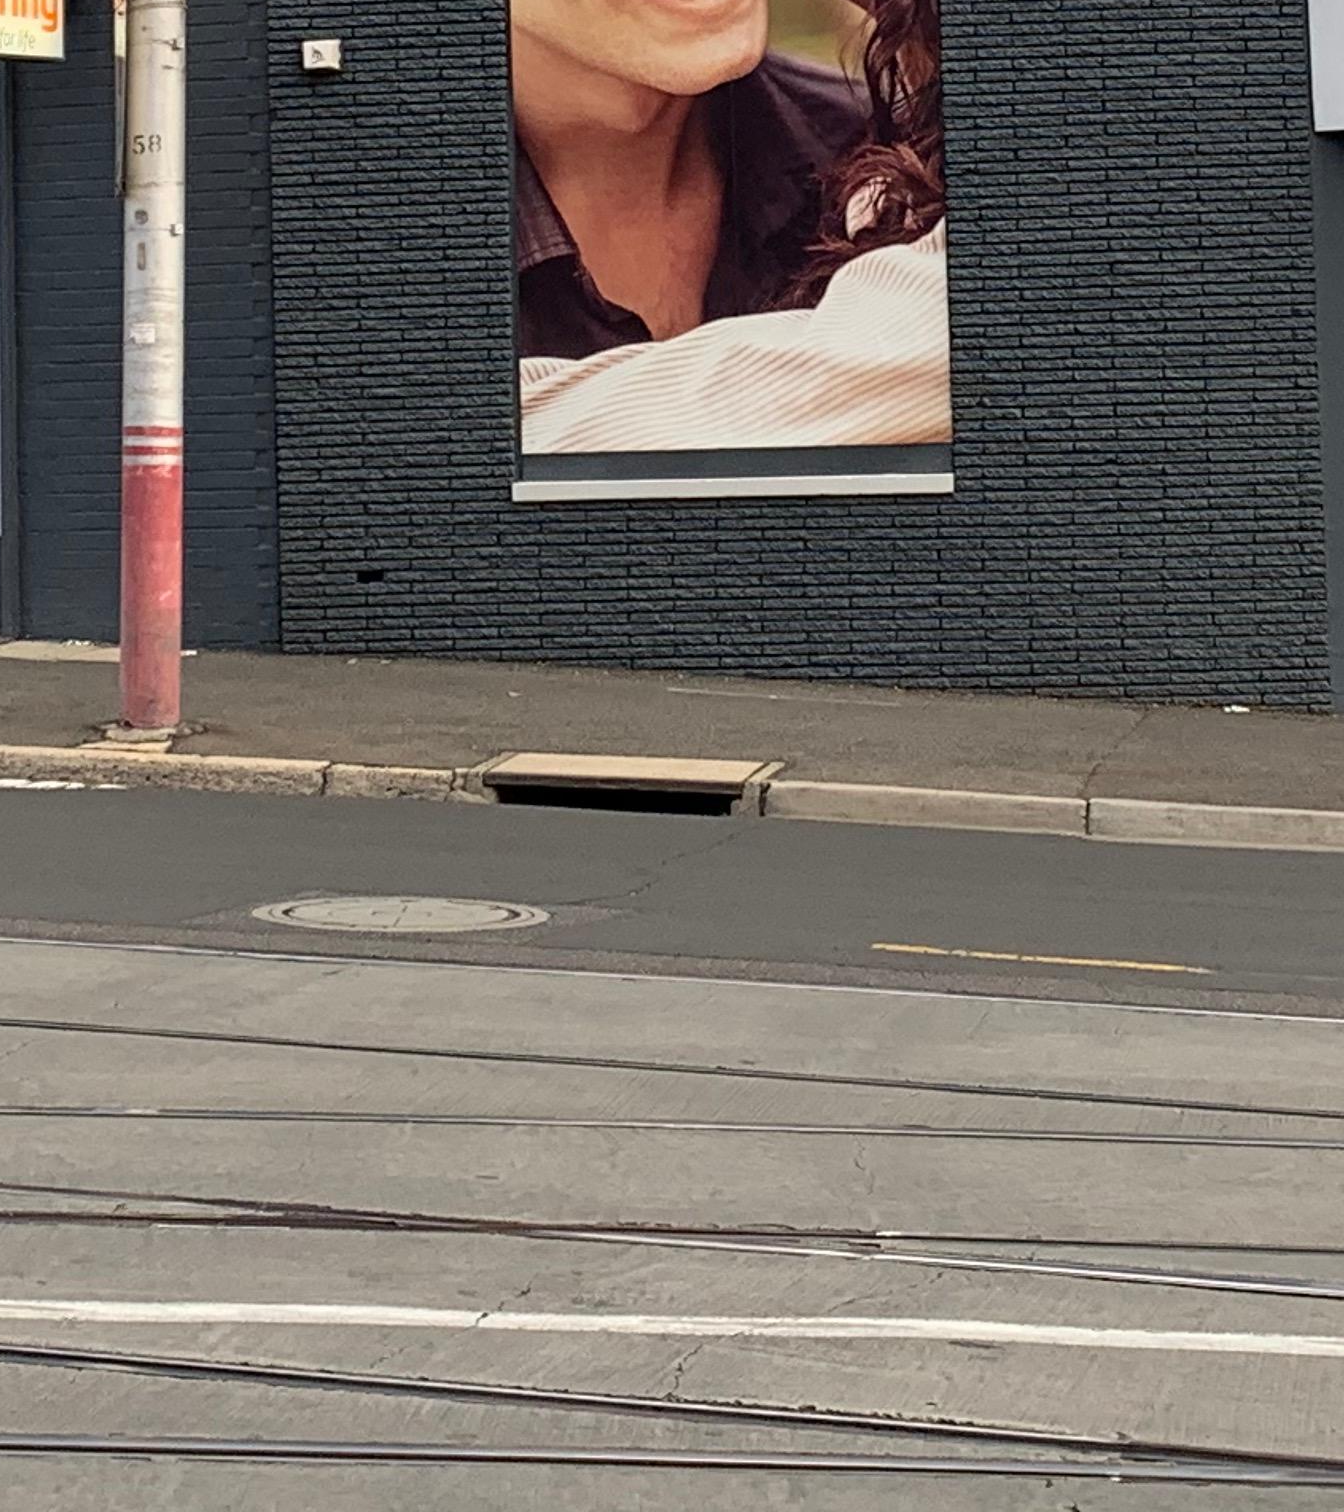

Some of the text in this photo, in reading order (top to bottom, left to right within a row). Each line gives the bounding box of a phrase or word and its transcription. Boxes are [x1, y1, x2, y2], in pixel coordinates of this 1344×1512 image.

[0, 26, 16, 50] for
[18, 28, 36, 52] life
[132, 134, 162, 155] 58
